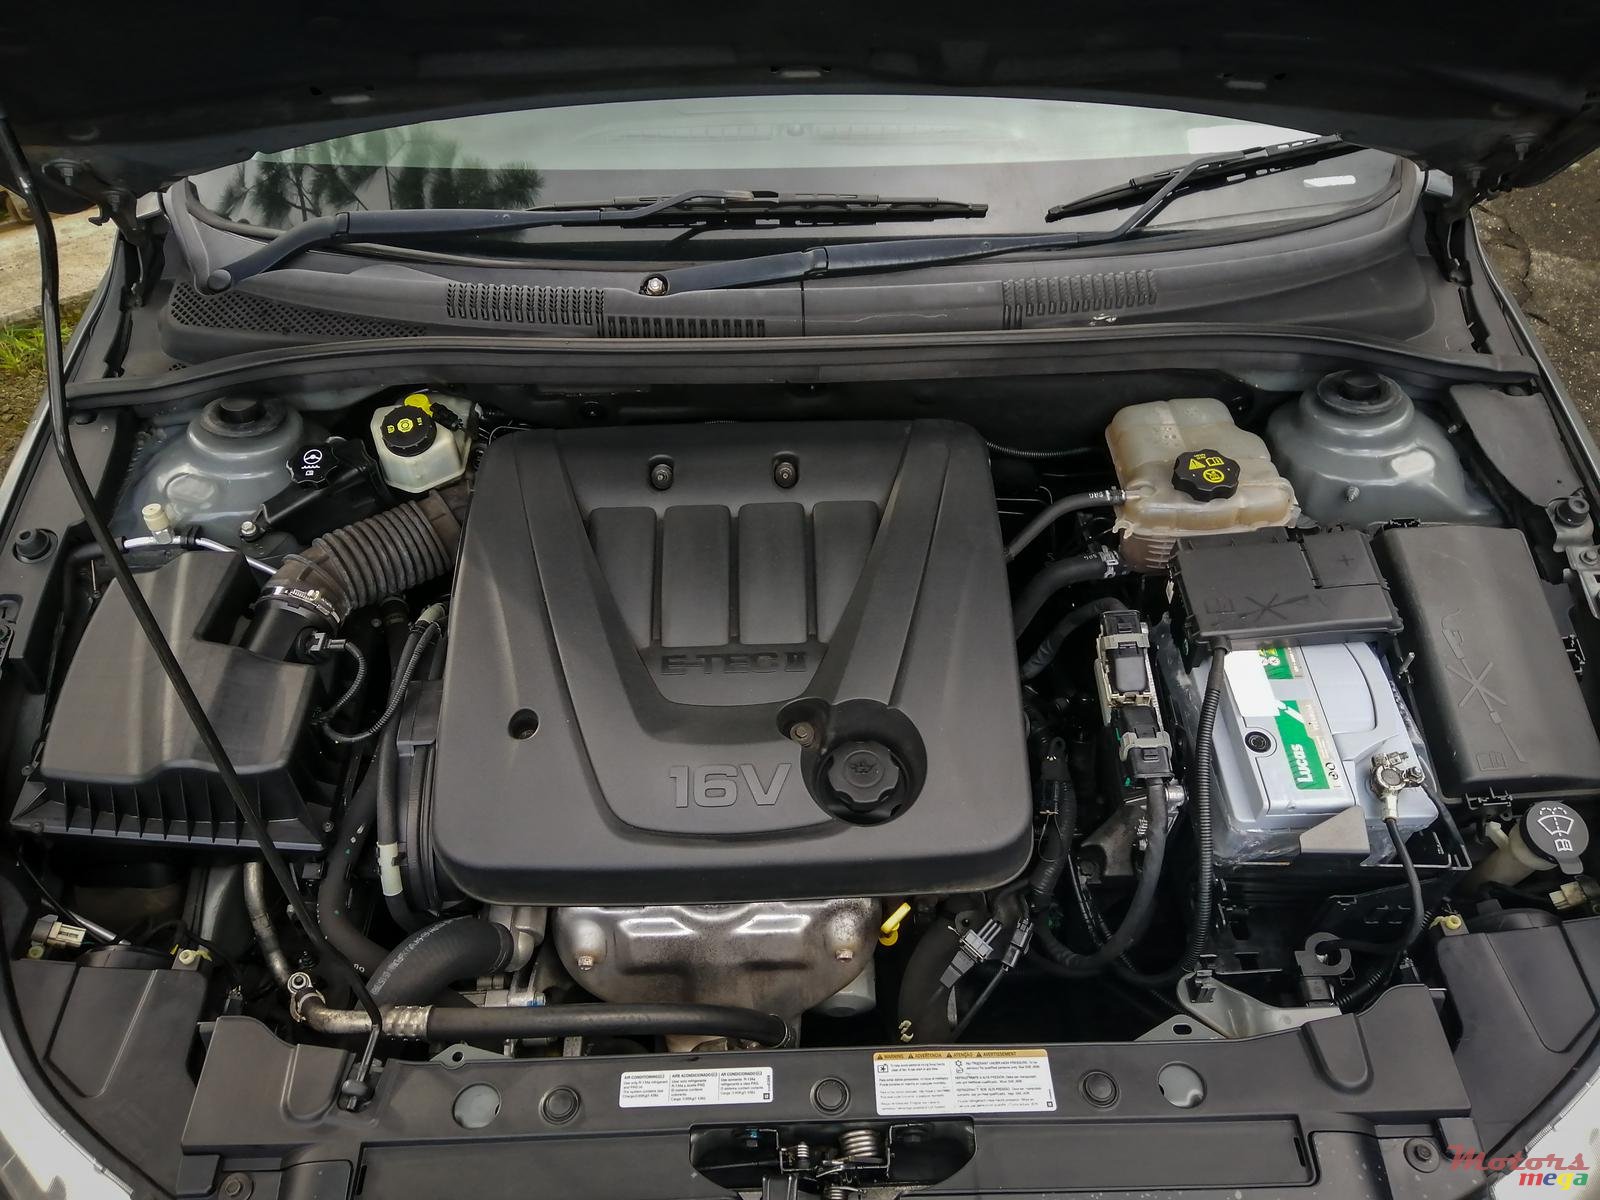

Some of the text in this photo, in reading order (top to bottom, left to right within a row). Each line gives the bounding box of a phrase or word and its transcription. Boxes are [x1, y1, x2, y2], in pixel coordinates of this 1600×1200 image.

[661, 652, 779, 676] E-TEC
[1291, 743, 1314, 783] Lucas
[669, 763, 792, 809] 16V
